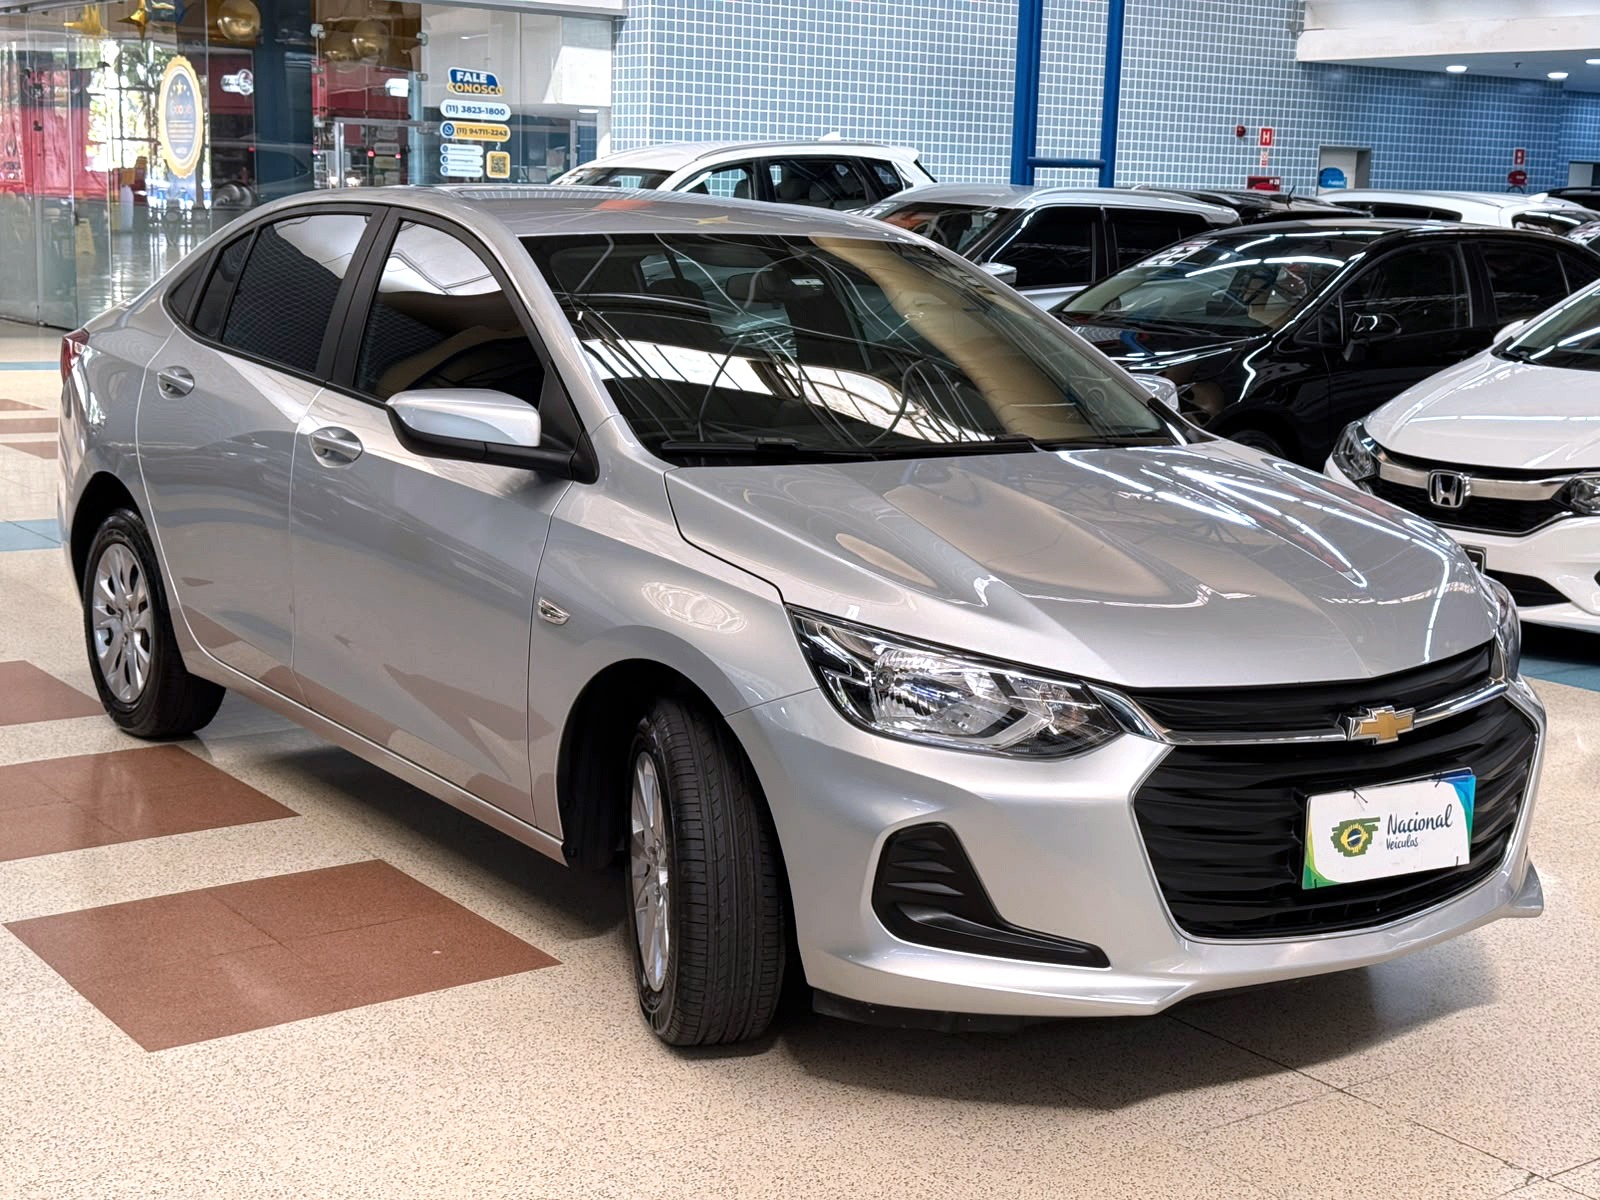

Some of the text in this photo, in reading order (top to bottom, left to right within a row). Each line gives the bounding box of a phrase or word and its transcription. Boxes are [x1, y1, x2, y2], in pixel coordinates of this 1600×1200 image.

[456, 71, 487, 83] FALE
[447, 82, 503, 95] CONOSCO
[445, 104, 506, 116] (11) 3823-1800
[456, 127, 467, 135] (11)
[1262, 130, 1270, 143] H
[1387, 804, 1453, 836] Nacional
